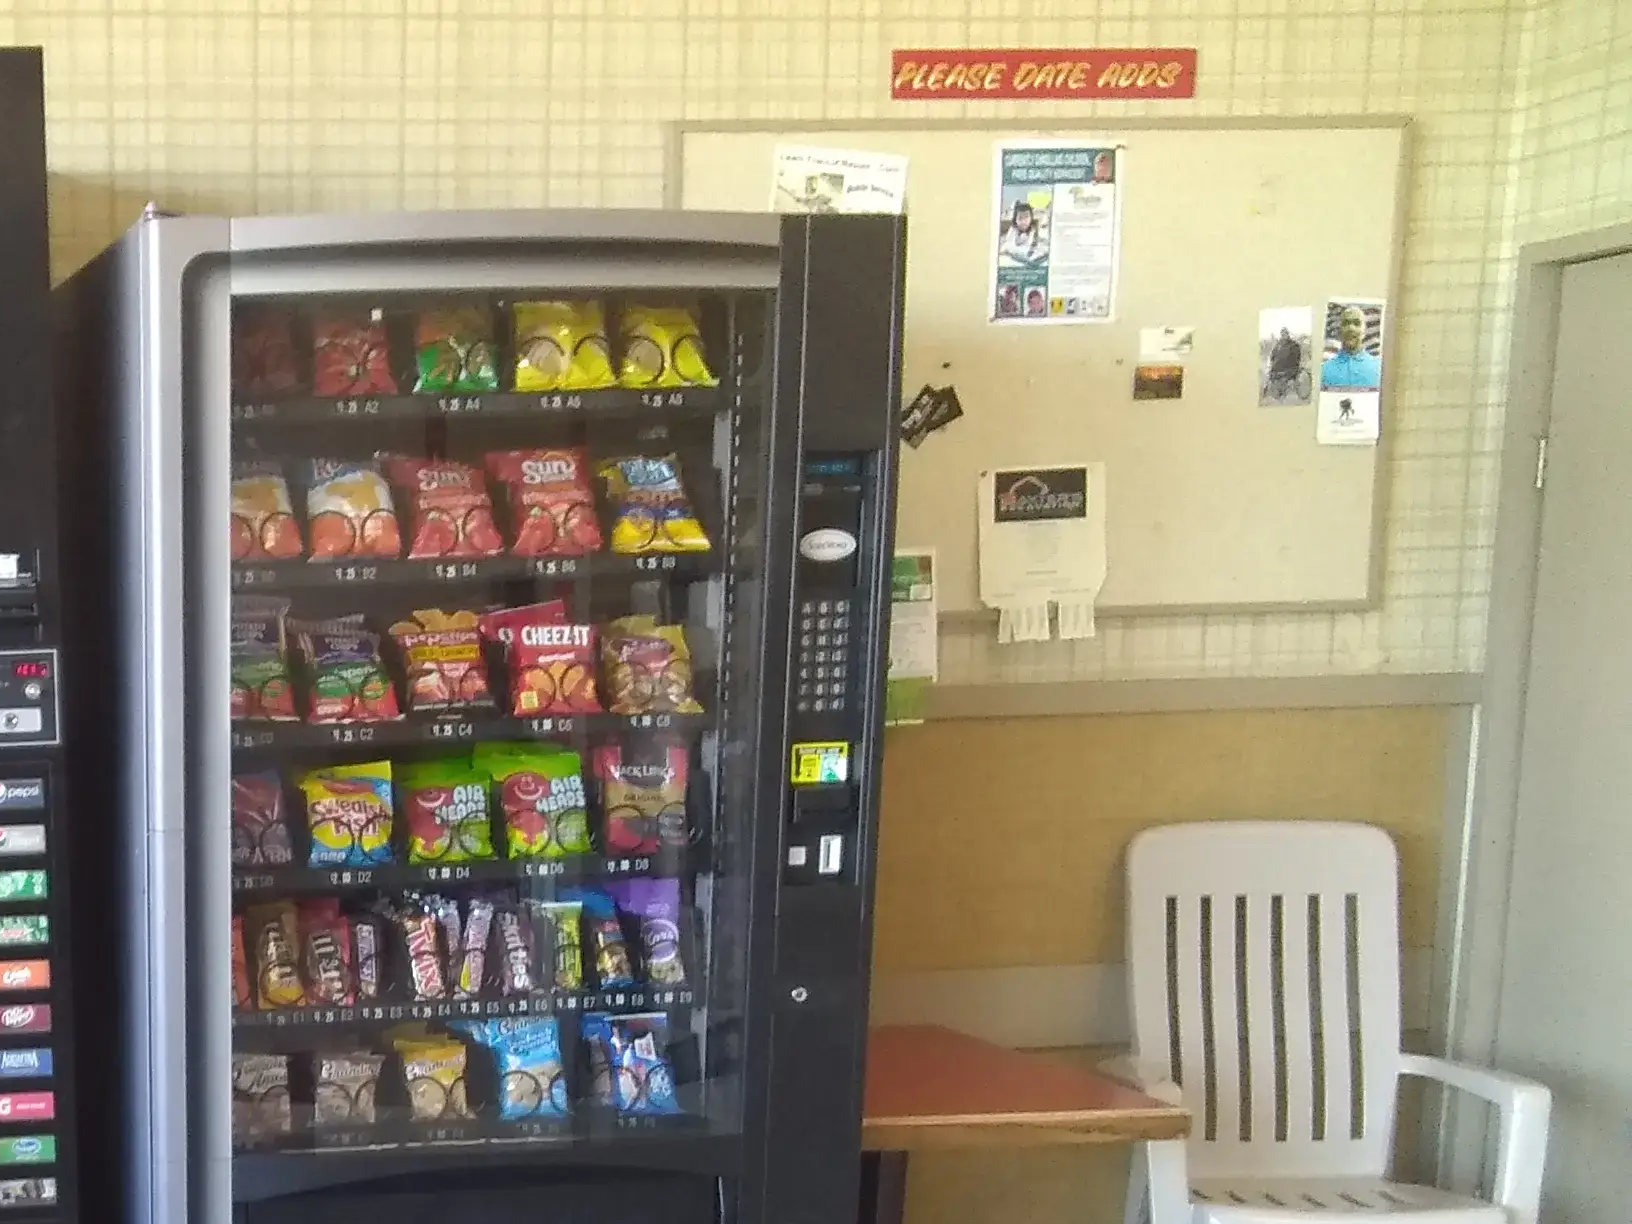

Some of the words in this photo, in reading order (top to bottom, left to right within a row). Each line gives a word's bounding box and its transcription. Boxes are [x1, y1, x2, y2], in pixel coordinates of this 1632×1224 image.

[895, 60, 1006, 91] PLEASE
[1013, 60, 1091, 91] DATE
[359, 728, 374, 741] C2
[458, 724, 472, 736] C4
[550, 775, 584, 795] AIR
[7, 786, 39, 799] pepsi
[453, 785, 485, 803] AIR
[536, 791, 585, 813] HEADS
[309, 798, 390, 820] Swedish
[357, 871, 372, 884] D2
[456, 866, 470, 880] D4
[535, 999, 547, 1012] E6
[583, 996, 596, 1009] E7
[438, 1004, 451, 1017] E4
